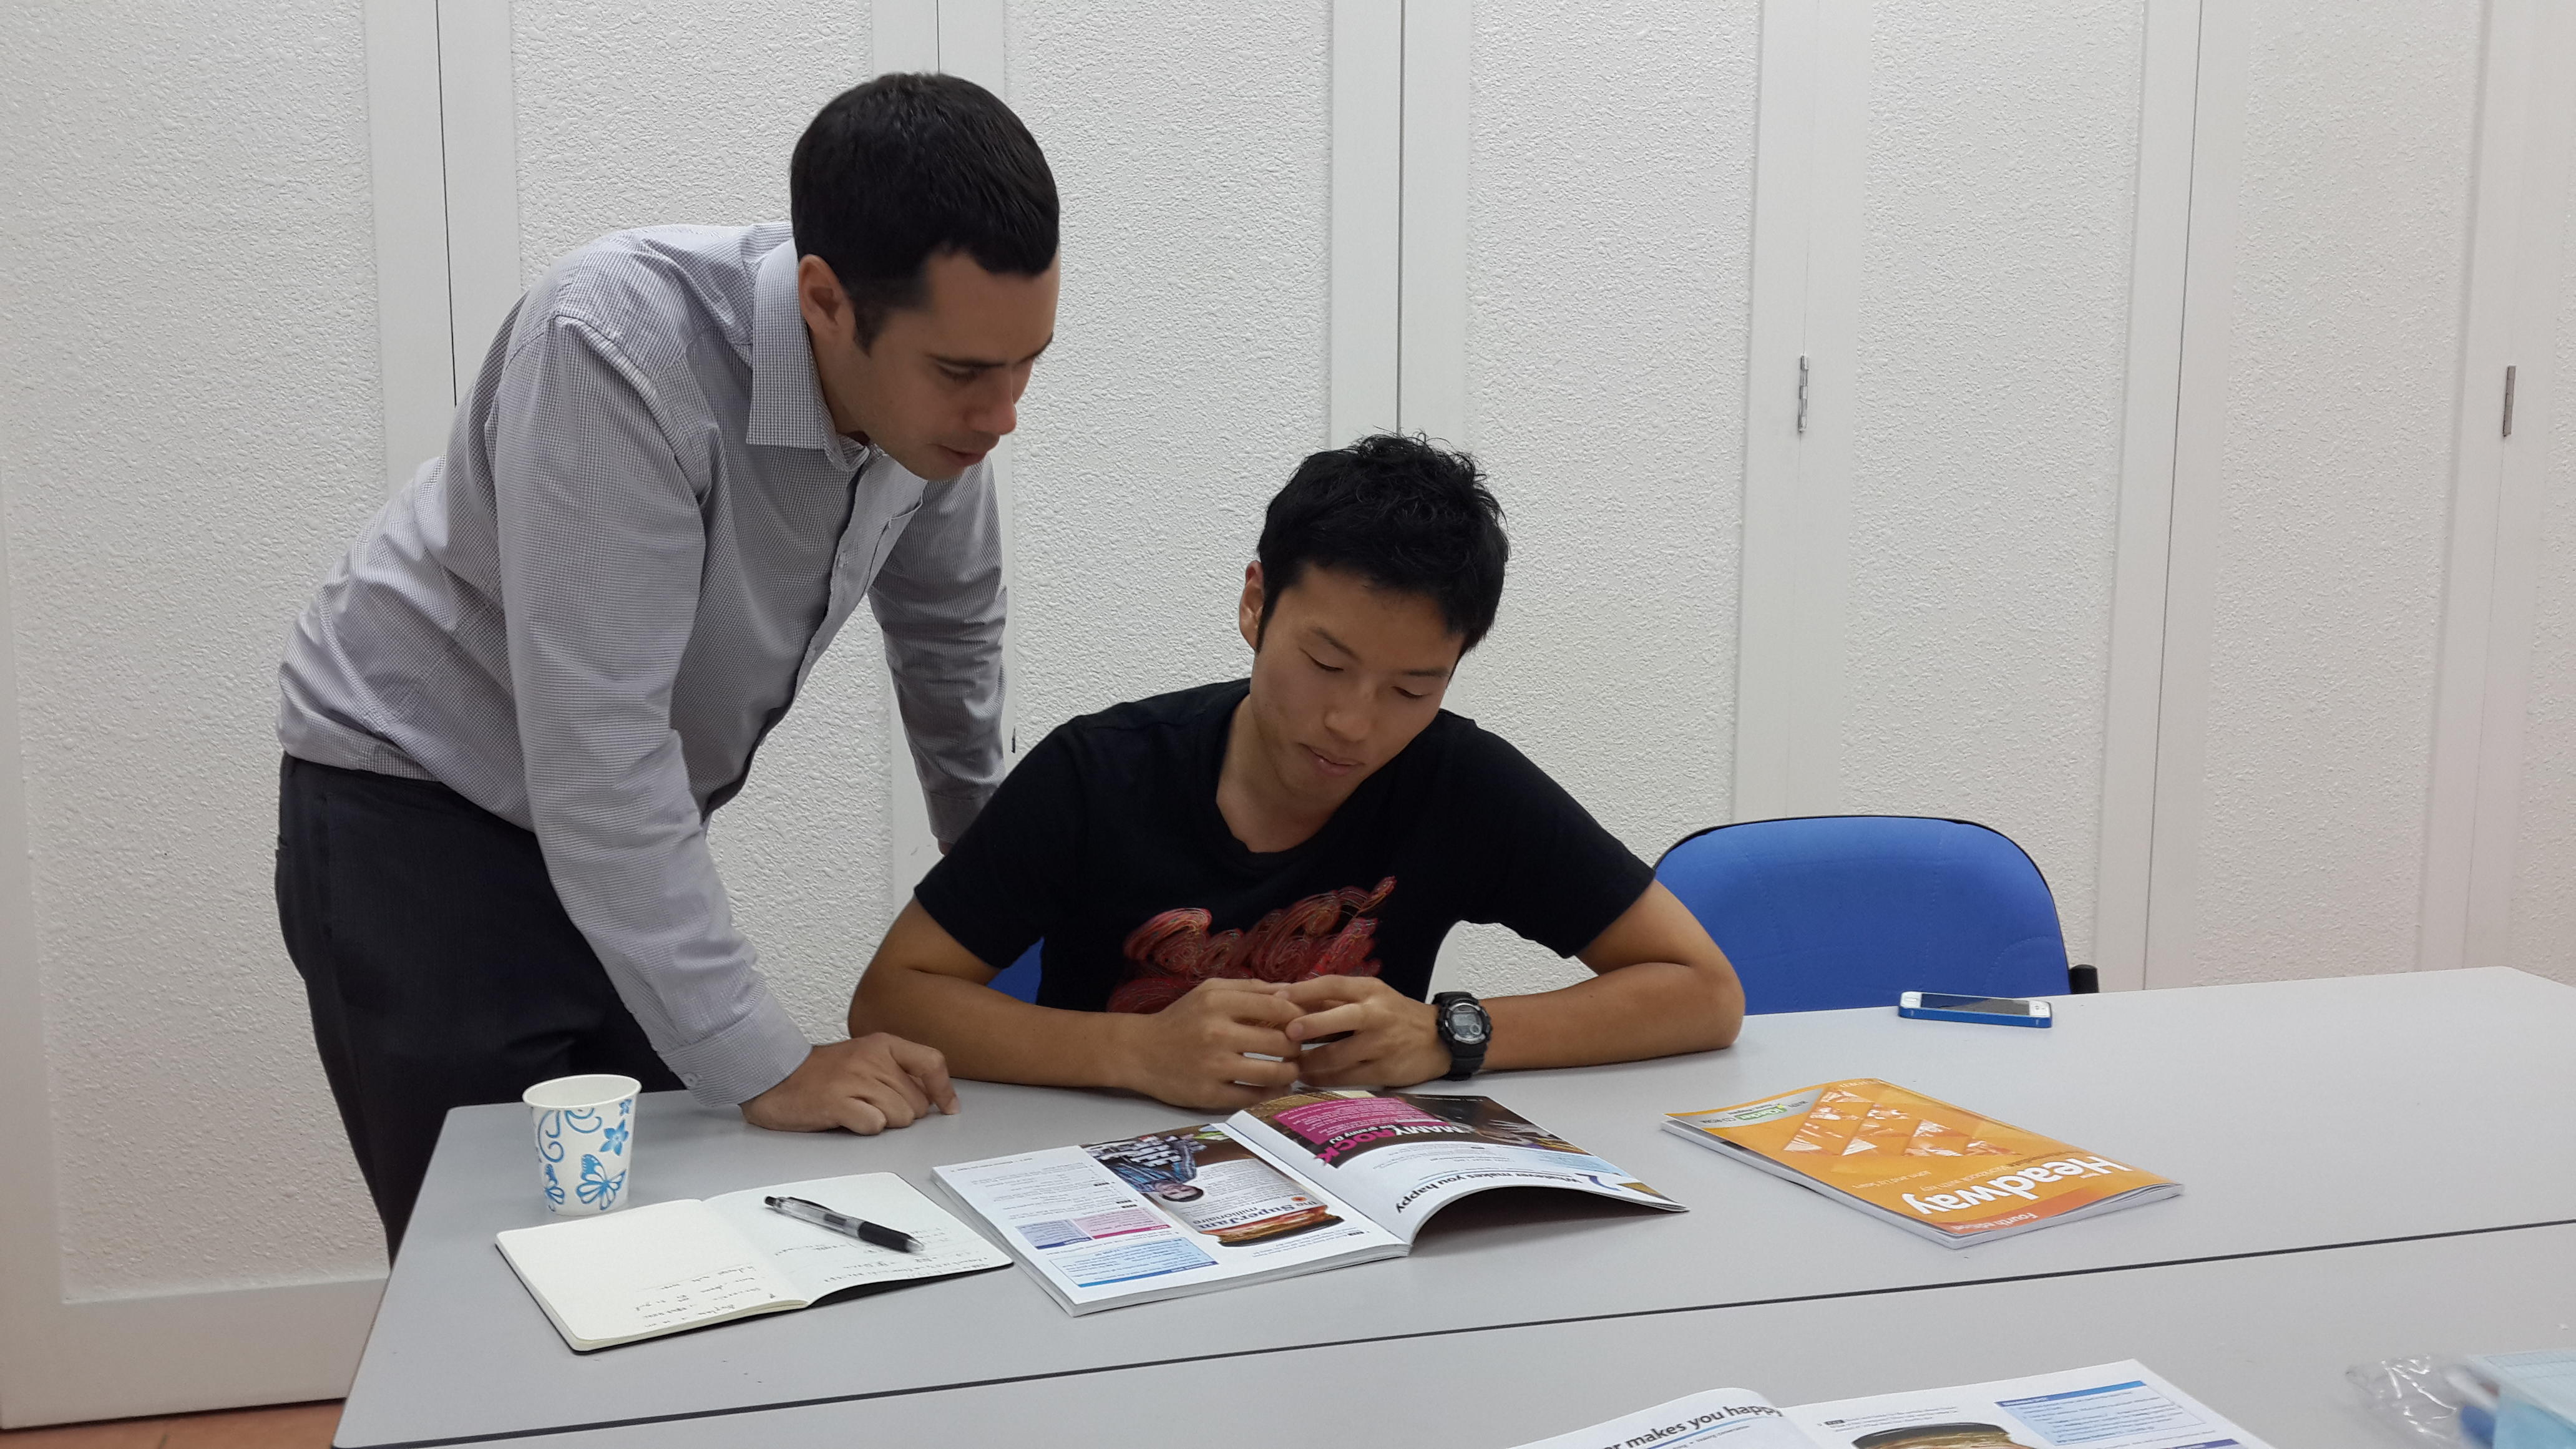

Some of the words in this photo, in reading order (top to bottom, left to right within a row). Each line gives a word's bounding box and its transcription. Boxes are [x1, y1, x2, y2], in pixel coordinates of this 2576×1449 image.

[1329, 1135, 1344, 1143] DJ
[1343, 1126, 1378, 1137] granny
[1438, 1174, 1468, 1186] you
[1468, 1172, 1513, 1180] makes
[1515, 1172, 1583, 1184] Whatever
[1901, 1156, 2134, 1214] Headway
[1395, 1183, 1439, 1214] happy
[1193, 1207, 1258, 1225] millionaire
[1199, 1204, 1295, 1229] SuperJam
[1993, 1212, 2038, 1228] Fourth
[1626, 1423, 1687, 1448] makes
[1687, 1410, 1725, 1430] you
[1725, 1405, 1783, 1417] happy
